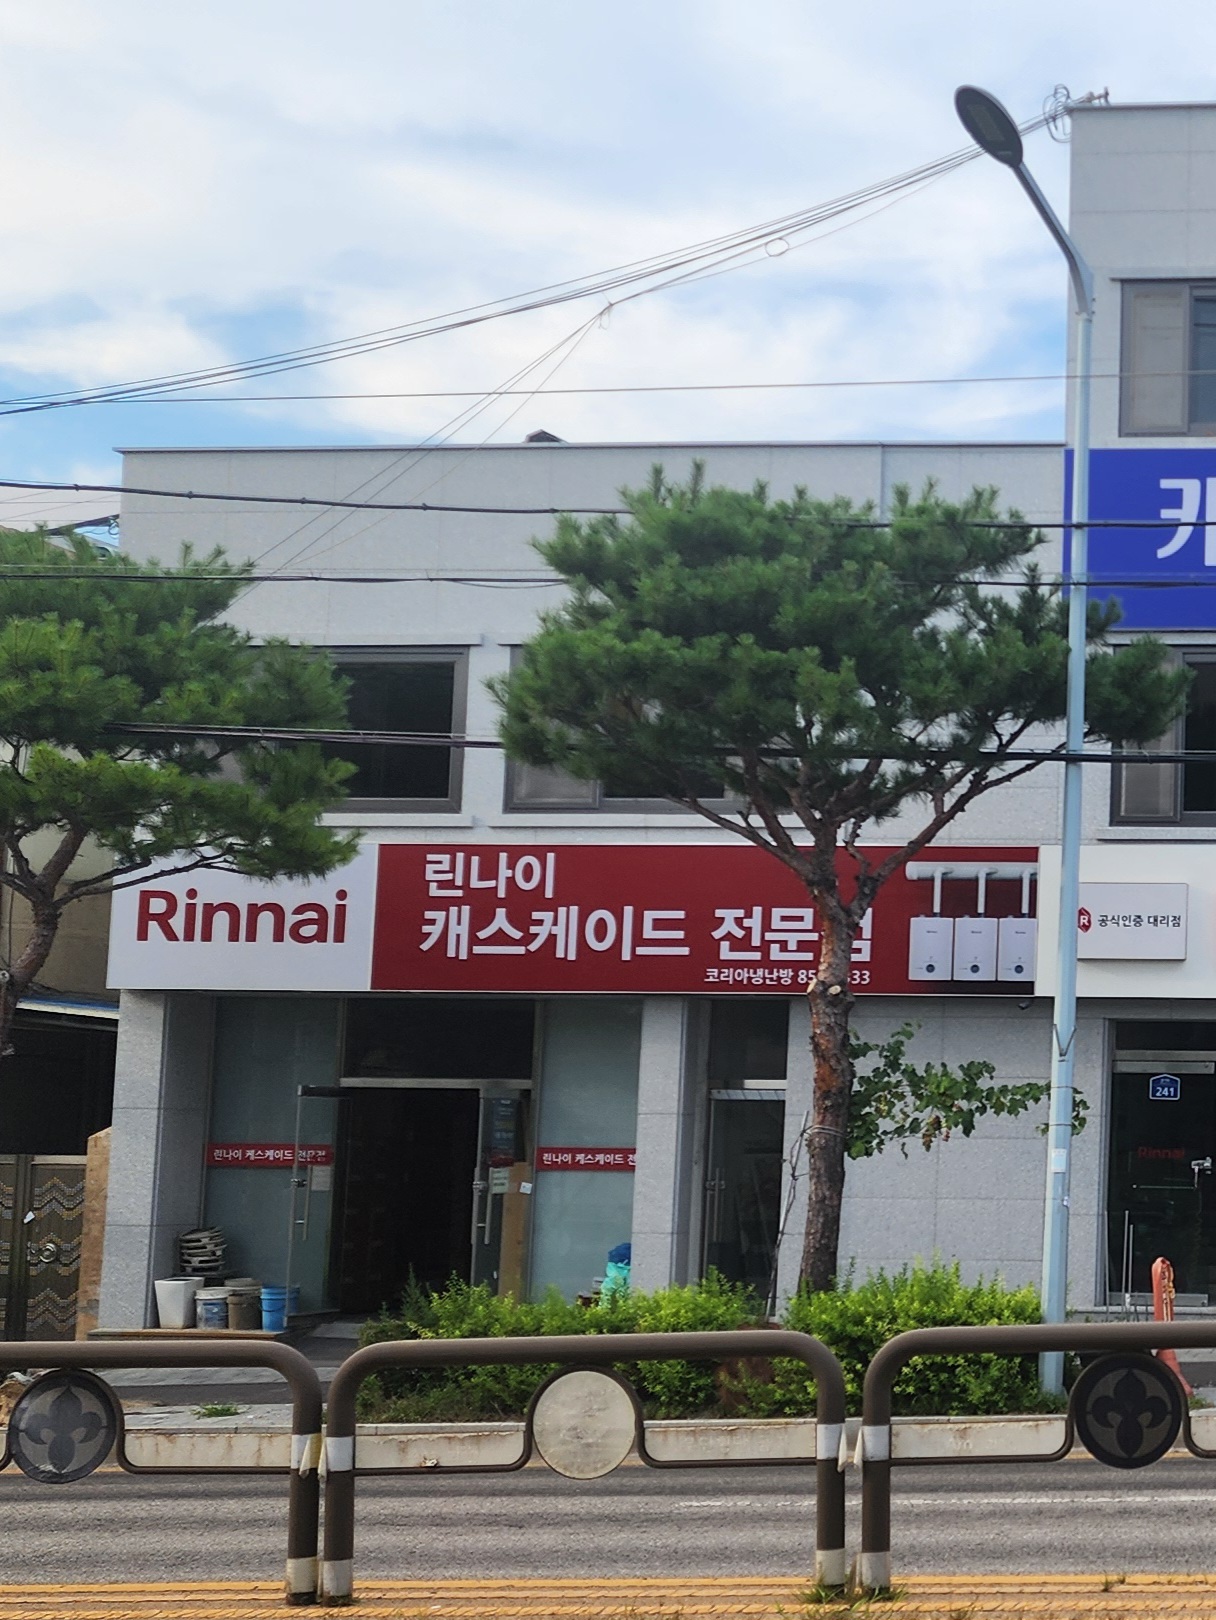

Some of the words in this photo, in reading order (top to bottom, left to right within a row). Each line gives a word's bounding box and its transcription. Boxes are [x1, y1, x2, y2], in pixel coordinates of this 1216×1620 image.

[425, 852, 555, 899] 린나이
[136, 888, 348, 944] Rinnai
[1098, 914, 1144, 928] 공식인증
[1147, 914, 1182, 928] 대리점
[418, 905, 690, 961] 캐스케이드
[704, 967, 794, 985] 코리아냉난방
[1155, 1086, 1175, 1097] 241
[213, 1149, 242, 1161] 린나이
[542, 1153, 572, 1165] 린나이
